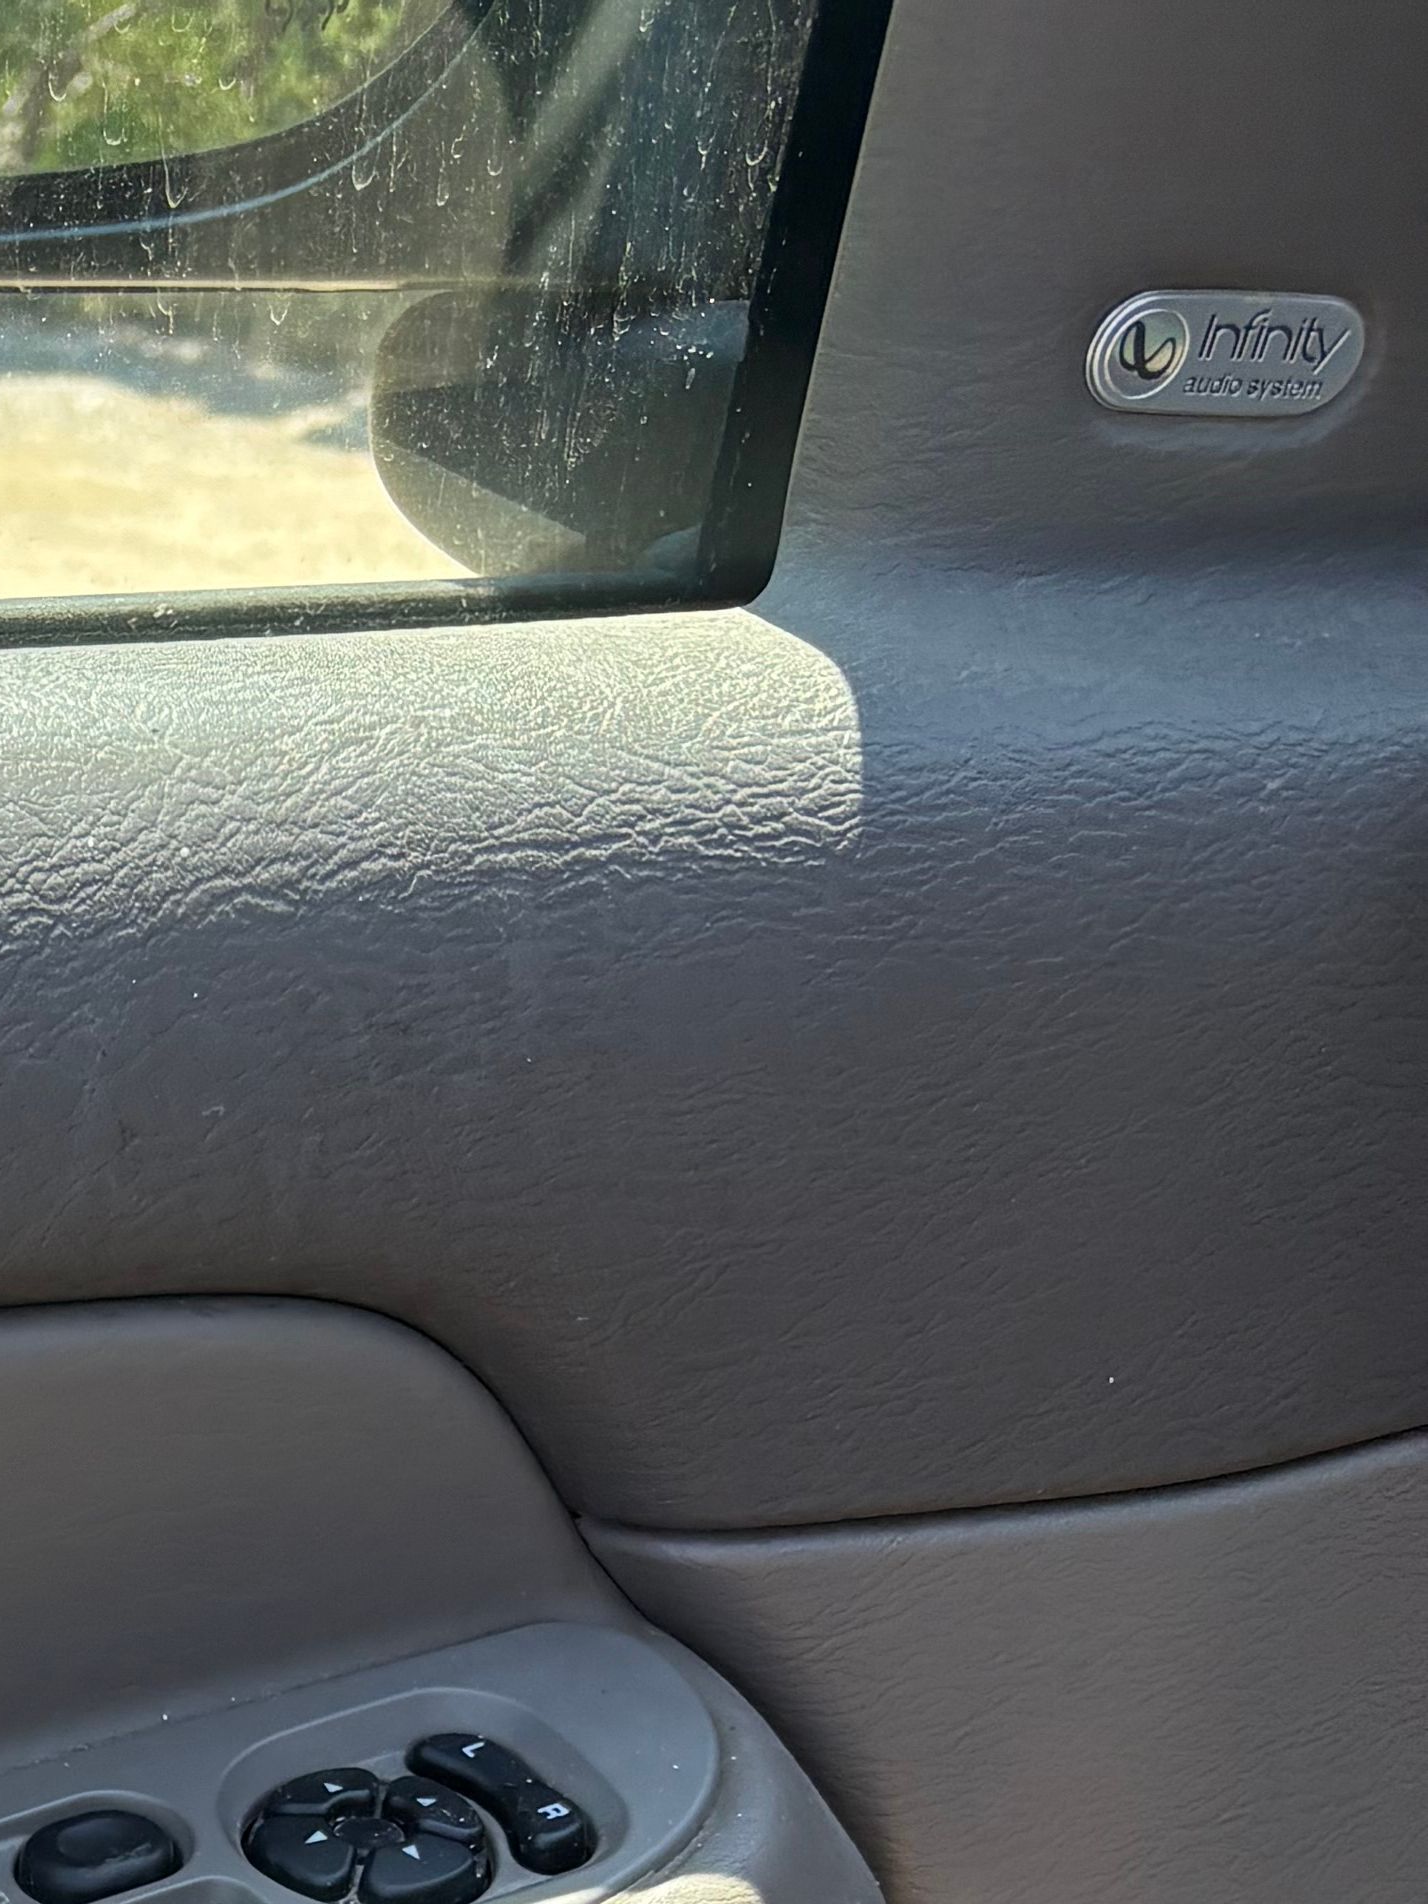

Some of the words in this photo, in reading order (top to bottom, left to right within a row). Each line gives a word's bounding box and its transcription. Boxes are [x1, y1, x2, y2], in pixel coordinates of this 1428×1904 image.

[1197, 309, 1351, 376] Infinity
[1183, 376, 1242, 395] audio
[1246, 377, 1322, 401] system
[461, 1741, 486, 1759] L
[536, 1802, 571, 1820] R
